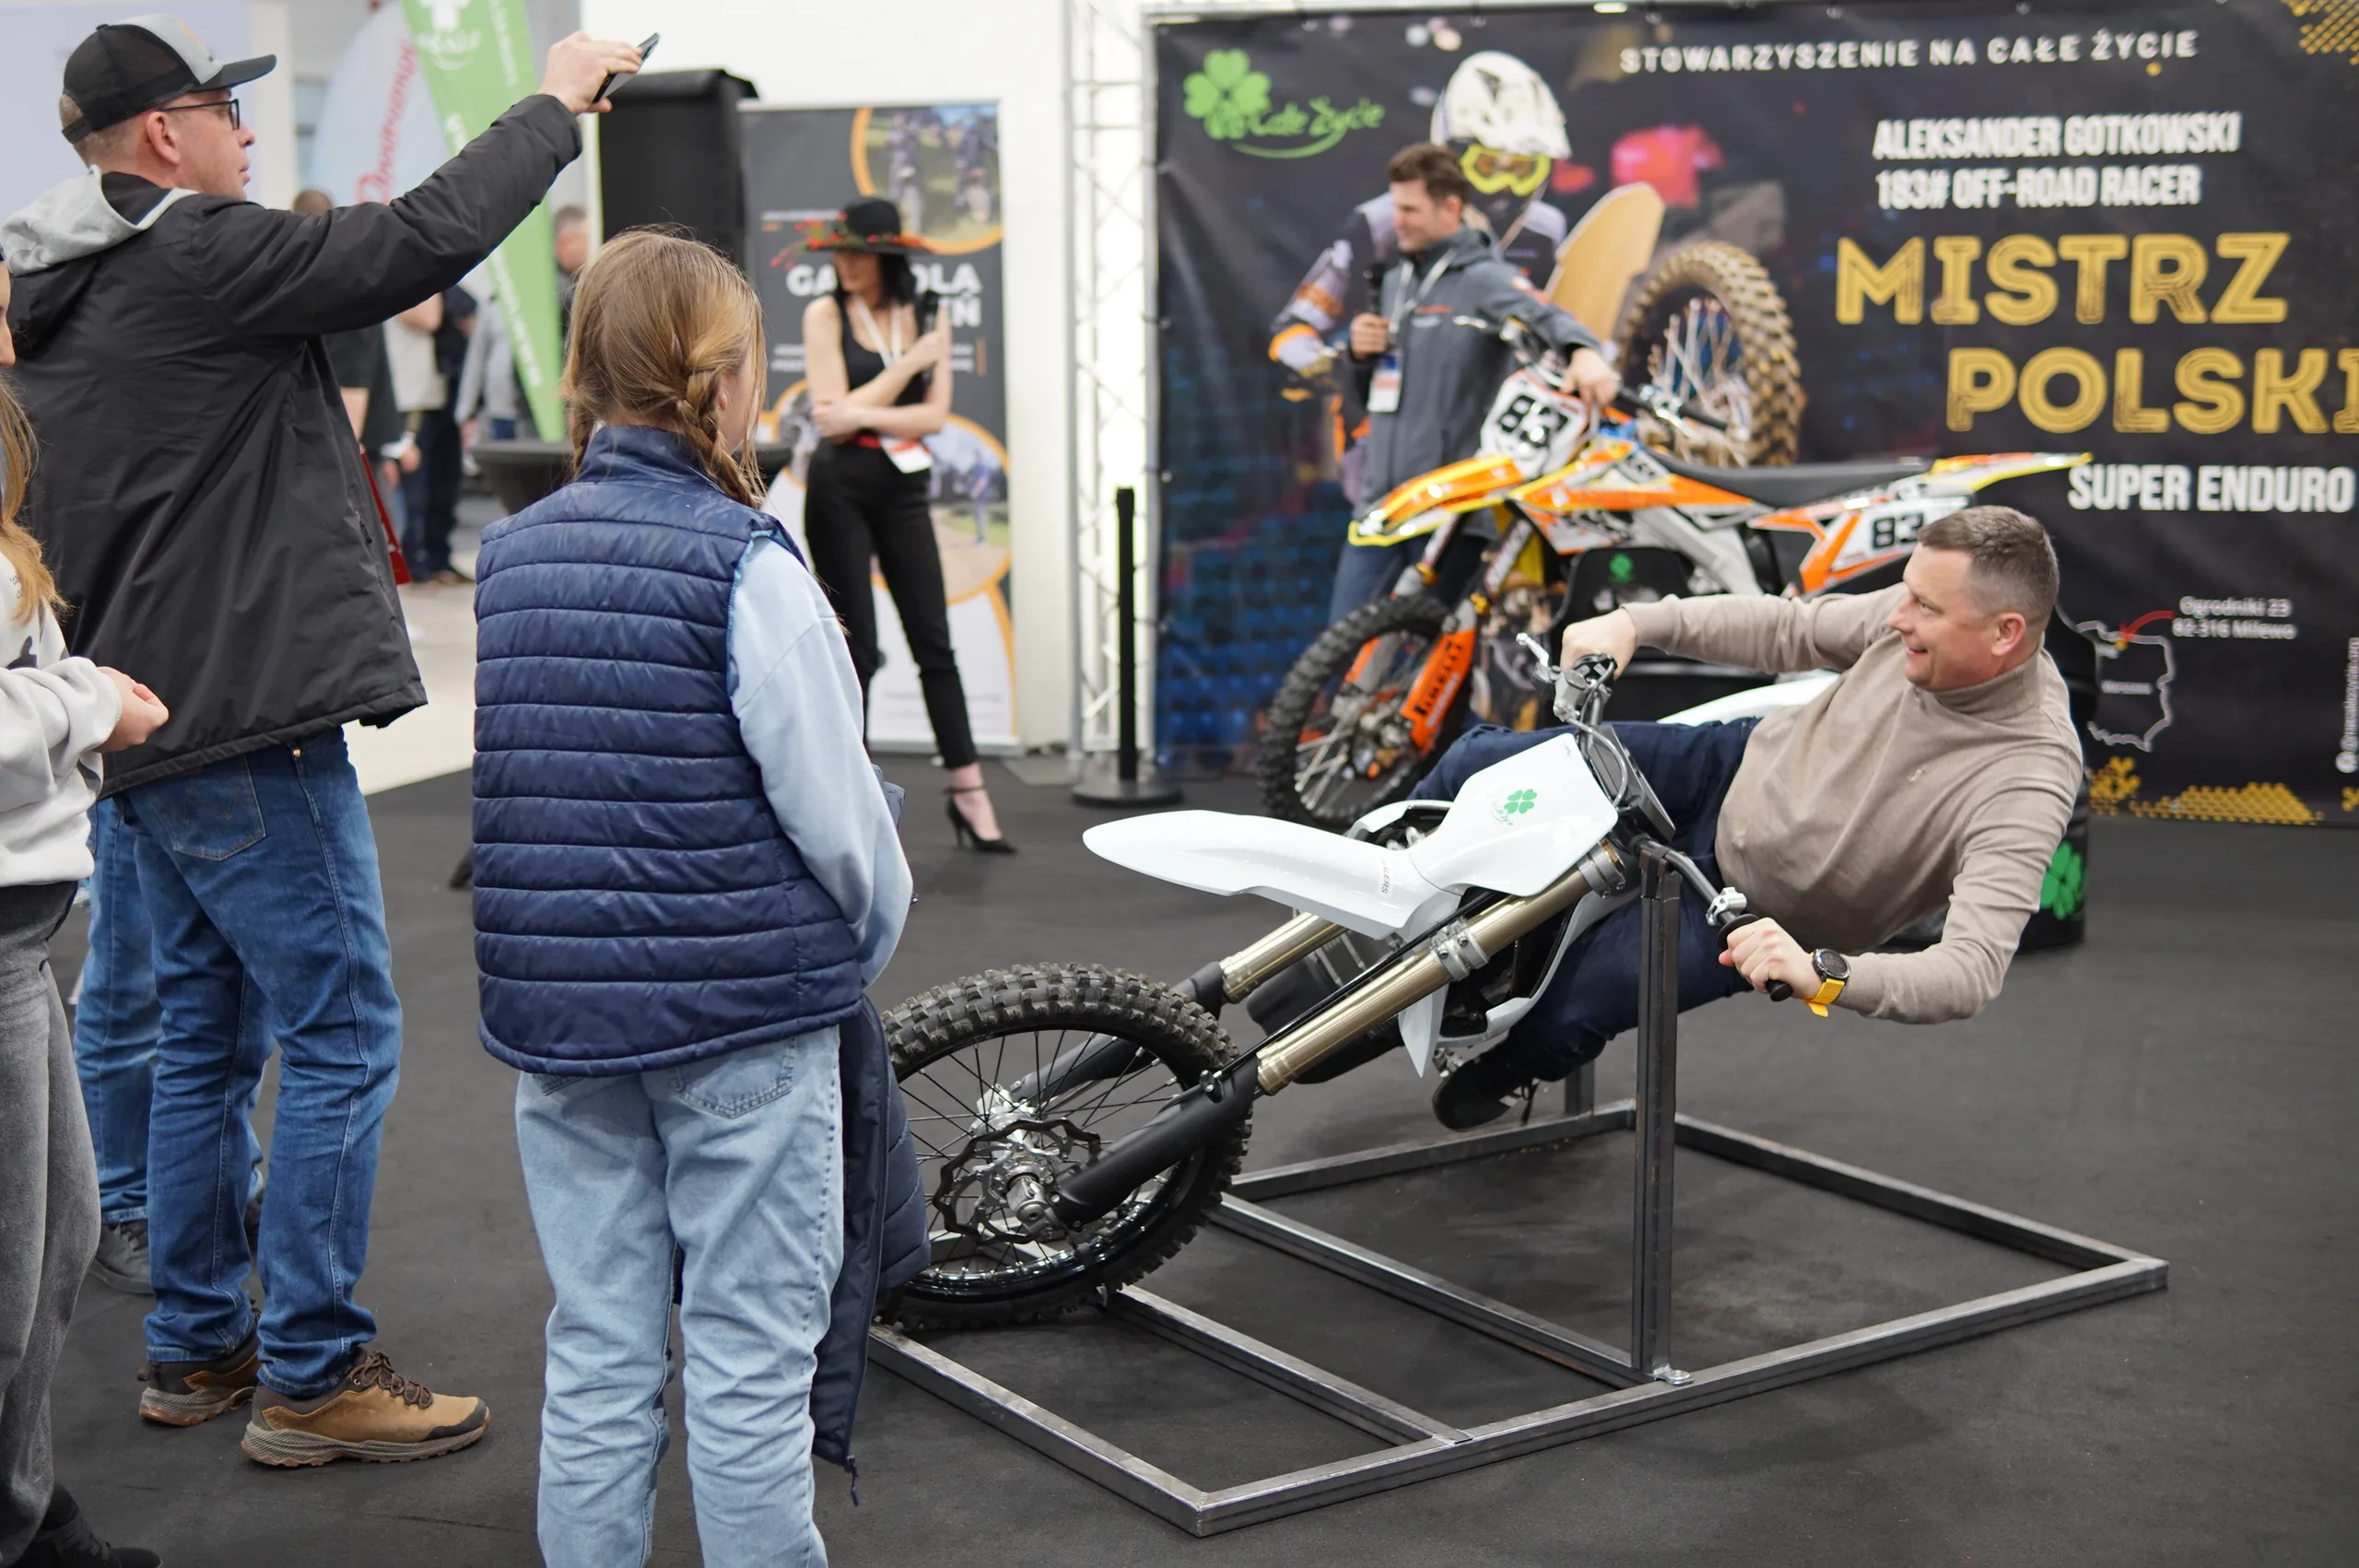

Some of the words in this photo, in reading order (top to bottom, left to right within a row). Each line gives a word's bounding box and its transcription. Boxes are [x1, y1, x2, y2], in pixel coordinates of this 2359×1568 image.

[1620, 40, 1919, 73] STOWARZYSZENIE
[1930, 37, 1976, 65] NA
[1987, 34, 2081, 64] CAŁE
[2091, 28, 2199, 61] ŻYCIE
[1872, 115, 2060, 159] ALEKSANDER
[2064, 111, 2241, 155] GOTKOWSKI
[1875, 169, 1951, 209] 183#
[1952, 165, 2097, 208] OFF-ROAD
[2100, 164, 2201, 205] RACER
[1836, 233, 2291, 325] MISTRZ
[1497, 394, 1569, 449] 83
[2068, 464, 2191, 510] SUPER
[2197, 465, 2356, 512] ENDURO
[1872, 512, 1924, 549] 83
[2179, 596, 2266, 619] Ogrodniki
